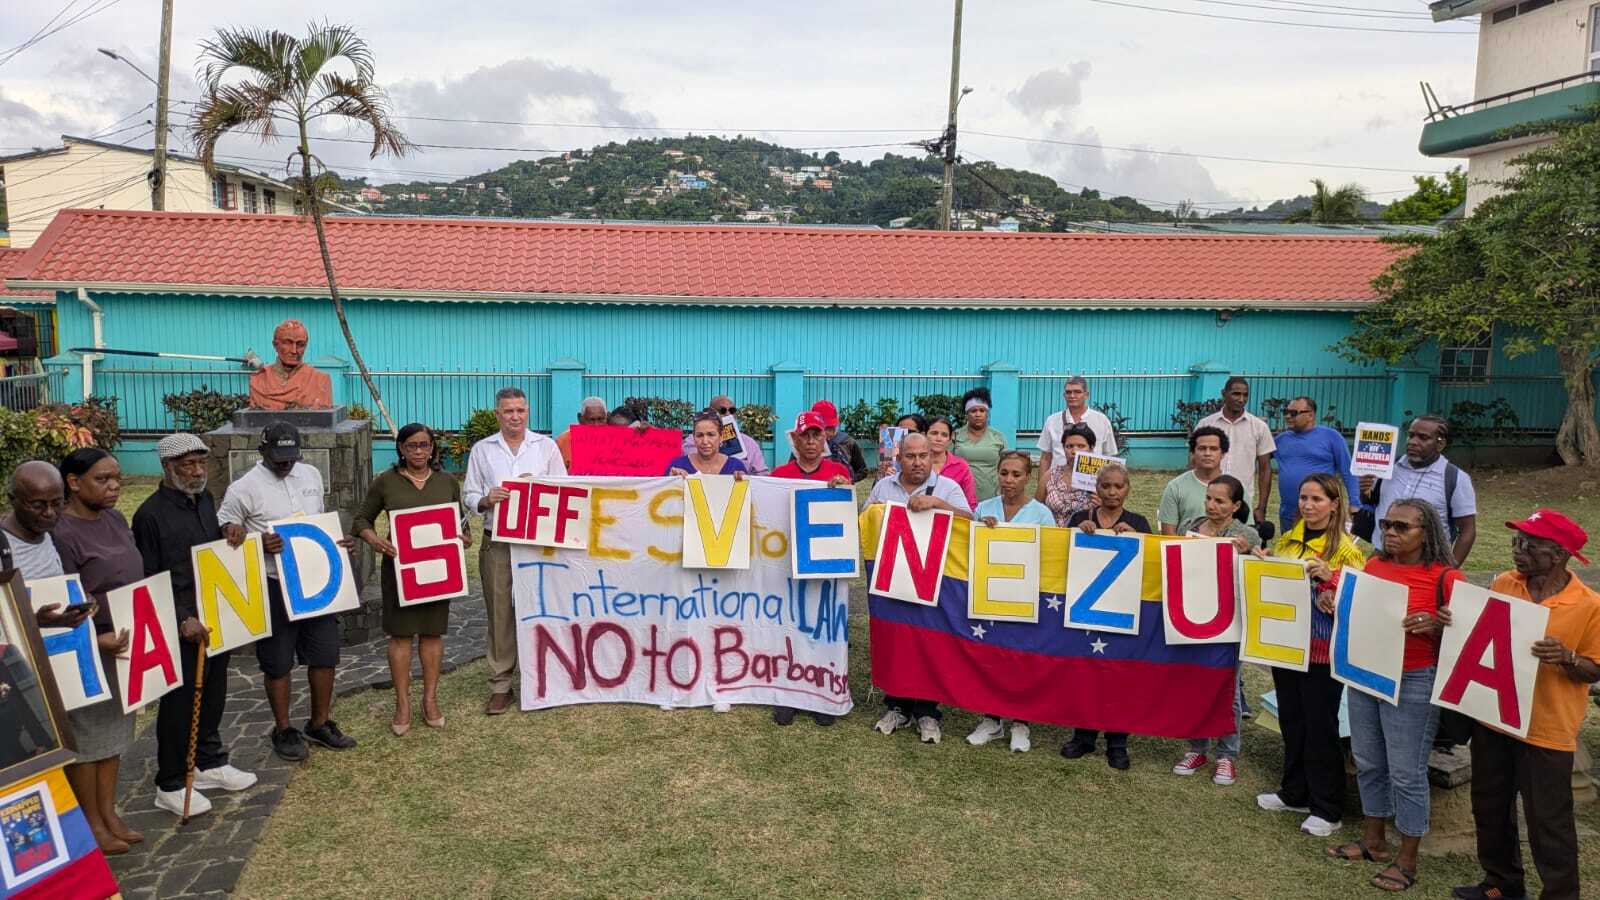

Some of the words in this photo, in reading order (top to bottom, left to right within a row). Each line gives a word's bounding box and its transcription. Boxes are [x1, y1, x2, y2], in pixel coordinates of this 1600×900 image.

[1079, 455, 1089, 465] NO
[1361, 430, 1391, 441] HANDS
[395, 507, 463, 601] S
[497, 480, 588, 543] OFF
[687, 478, 749, 567] V
[794, 488, 856, 574] E
[875, 506, 952, 602] N
[196, 539, 268, 653] N
[272, 522, 343, 615] D
[518, 561, 795, 625] International
[973, 526, 1038, 617] E
[1069, 532, 1140, 630] Z
[1165, 542, 1235, 640] U
[1243, 559, 1305, 665] E
[127, 585, 178, 707] A
[535, 621, 635, 699] NO
[642, 624, 701, 692] to
[1334, 571, 1397, 698] L
[1439, 596, 1522, 730] A
